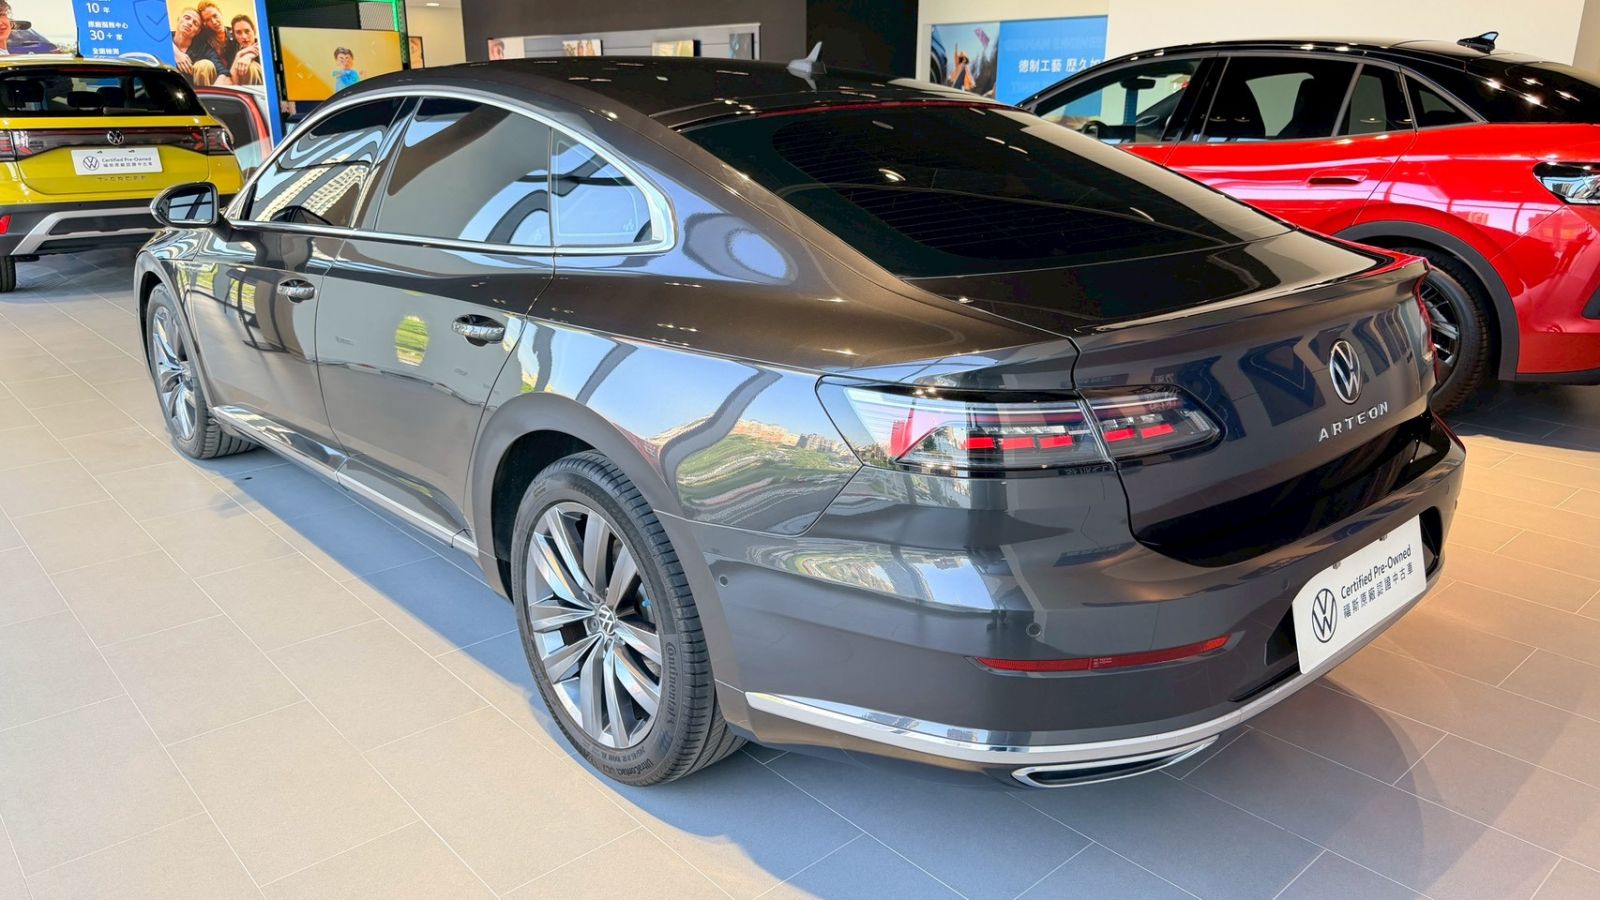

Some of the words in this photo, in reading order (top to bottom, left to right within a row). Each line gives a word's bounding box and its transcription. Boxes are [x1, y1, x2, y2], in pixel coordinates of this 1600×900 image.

[86, 2, 100, 14] 10
[1318, 401, 1388, 442] ARTEON
[1340, 569, 1373, 600] Certified
[1373, 544, 1412, 580] Pre-Owned
[1343, 561, 1414, 620] 福斯原廠認證中古車
[665, 641, 678, 718] Continental
